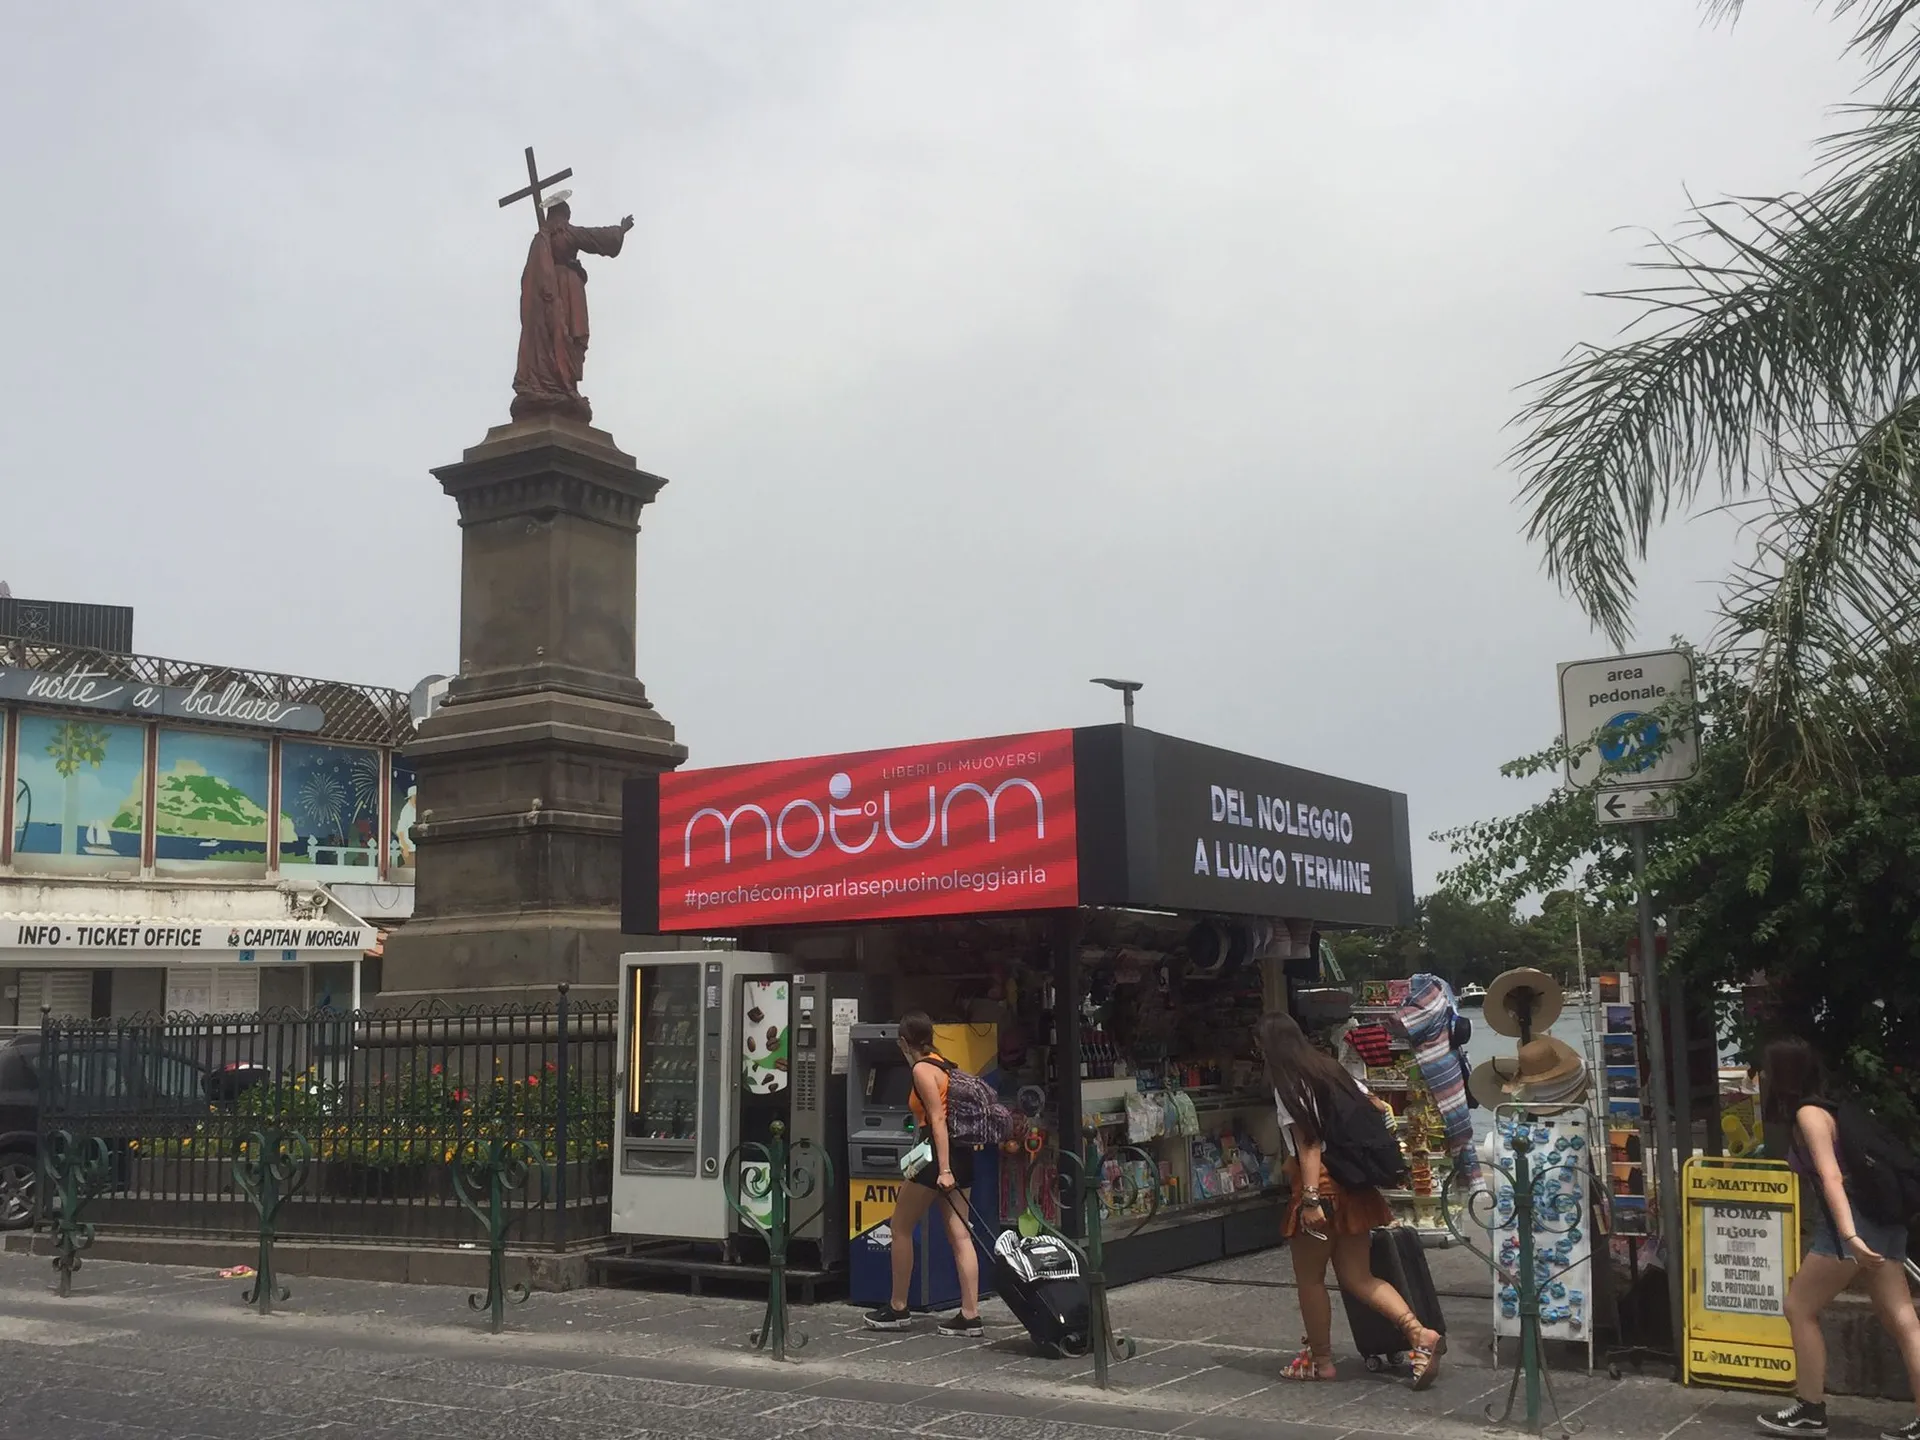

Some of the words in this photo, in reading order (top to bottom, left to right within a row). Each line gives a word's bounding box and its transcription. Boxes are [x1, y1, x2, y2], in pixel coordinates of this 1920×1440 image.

[1607, 667, 1643, 682] area
[27, 664, 124, 702] notte
[132, 686, 160, 708] a
[180, 674, 301, 722] ballare
[1589, 684, 1666, 707] pedonale
[883, 765, 930, 780] LIBERI
[937, 762, 952, 773] DI
[958, 752, 1042, 771] MUOVERSI
[1210, 784, 1254, 828] DEL
[1257, 794, 1353, 845] NOLEGGIO
[1194, 838, 1210, 876] A
[1215, 841, 1287, 885] LUNGO
[1291, 852, 1371, 895] TERMINE
[685, 864, 1046, 909] #perchécomprarlasepuoinoleggiarla
[18, 925, 61, 945] INFO
[77, 927, 140, 946] TICKET
[144, 928, 202, 947] OFFICE
[243, 929, 301, 947] CAPITAN
[305, 930, 360, 947] MORGAN
[1692, 1178, 1707, 1189] IL
[1717, 1179, 1788, 1194] MATTINO
[1713, 1207, 1772, 1220] ROMA
[1724, 1268, 1760, 1282] RIFLETTORI
[1711, 1281, 1723, 1293] SUL
[1725, 1282, 1766, 1297] PROTOCOLLO
[1768, 1285, 1775, 1297] DI
[1707, 1295, 1742, 1308] SICUREZZA
[1743, 1297, 1758, 1309] ANTI
[1760, 1299, 1780, 1312] COVID
[1692, 1351, 1707, 1363] IL
[1718, 1352, 1791, 1371] MATTINO
